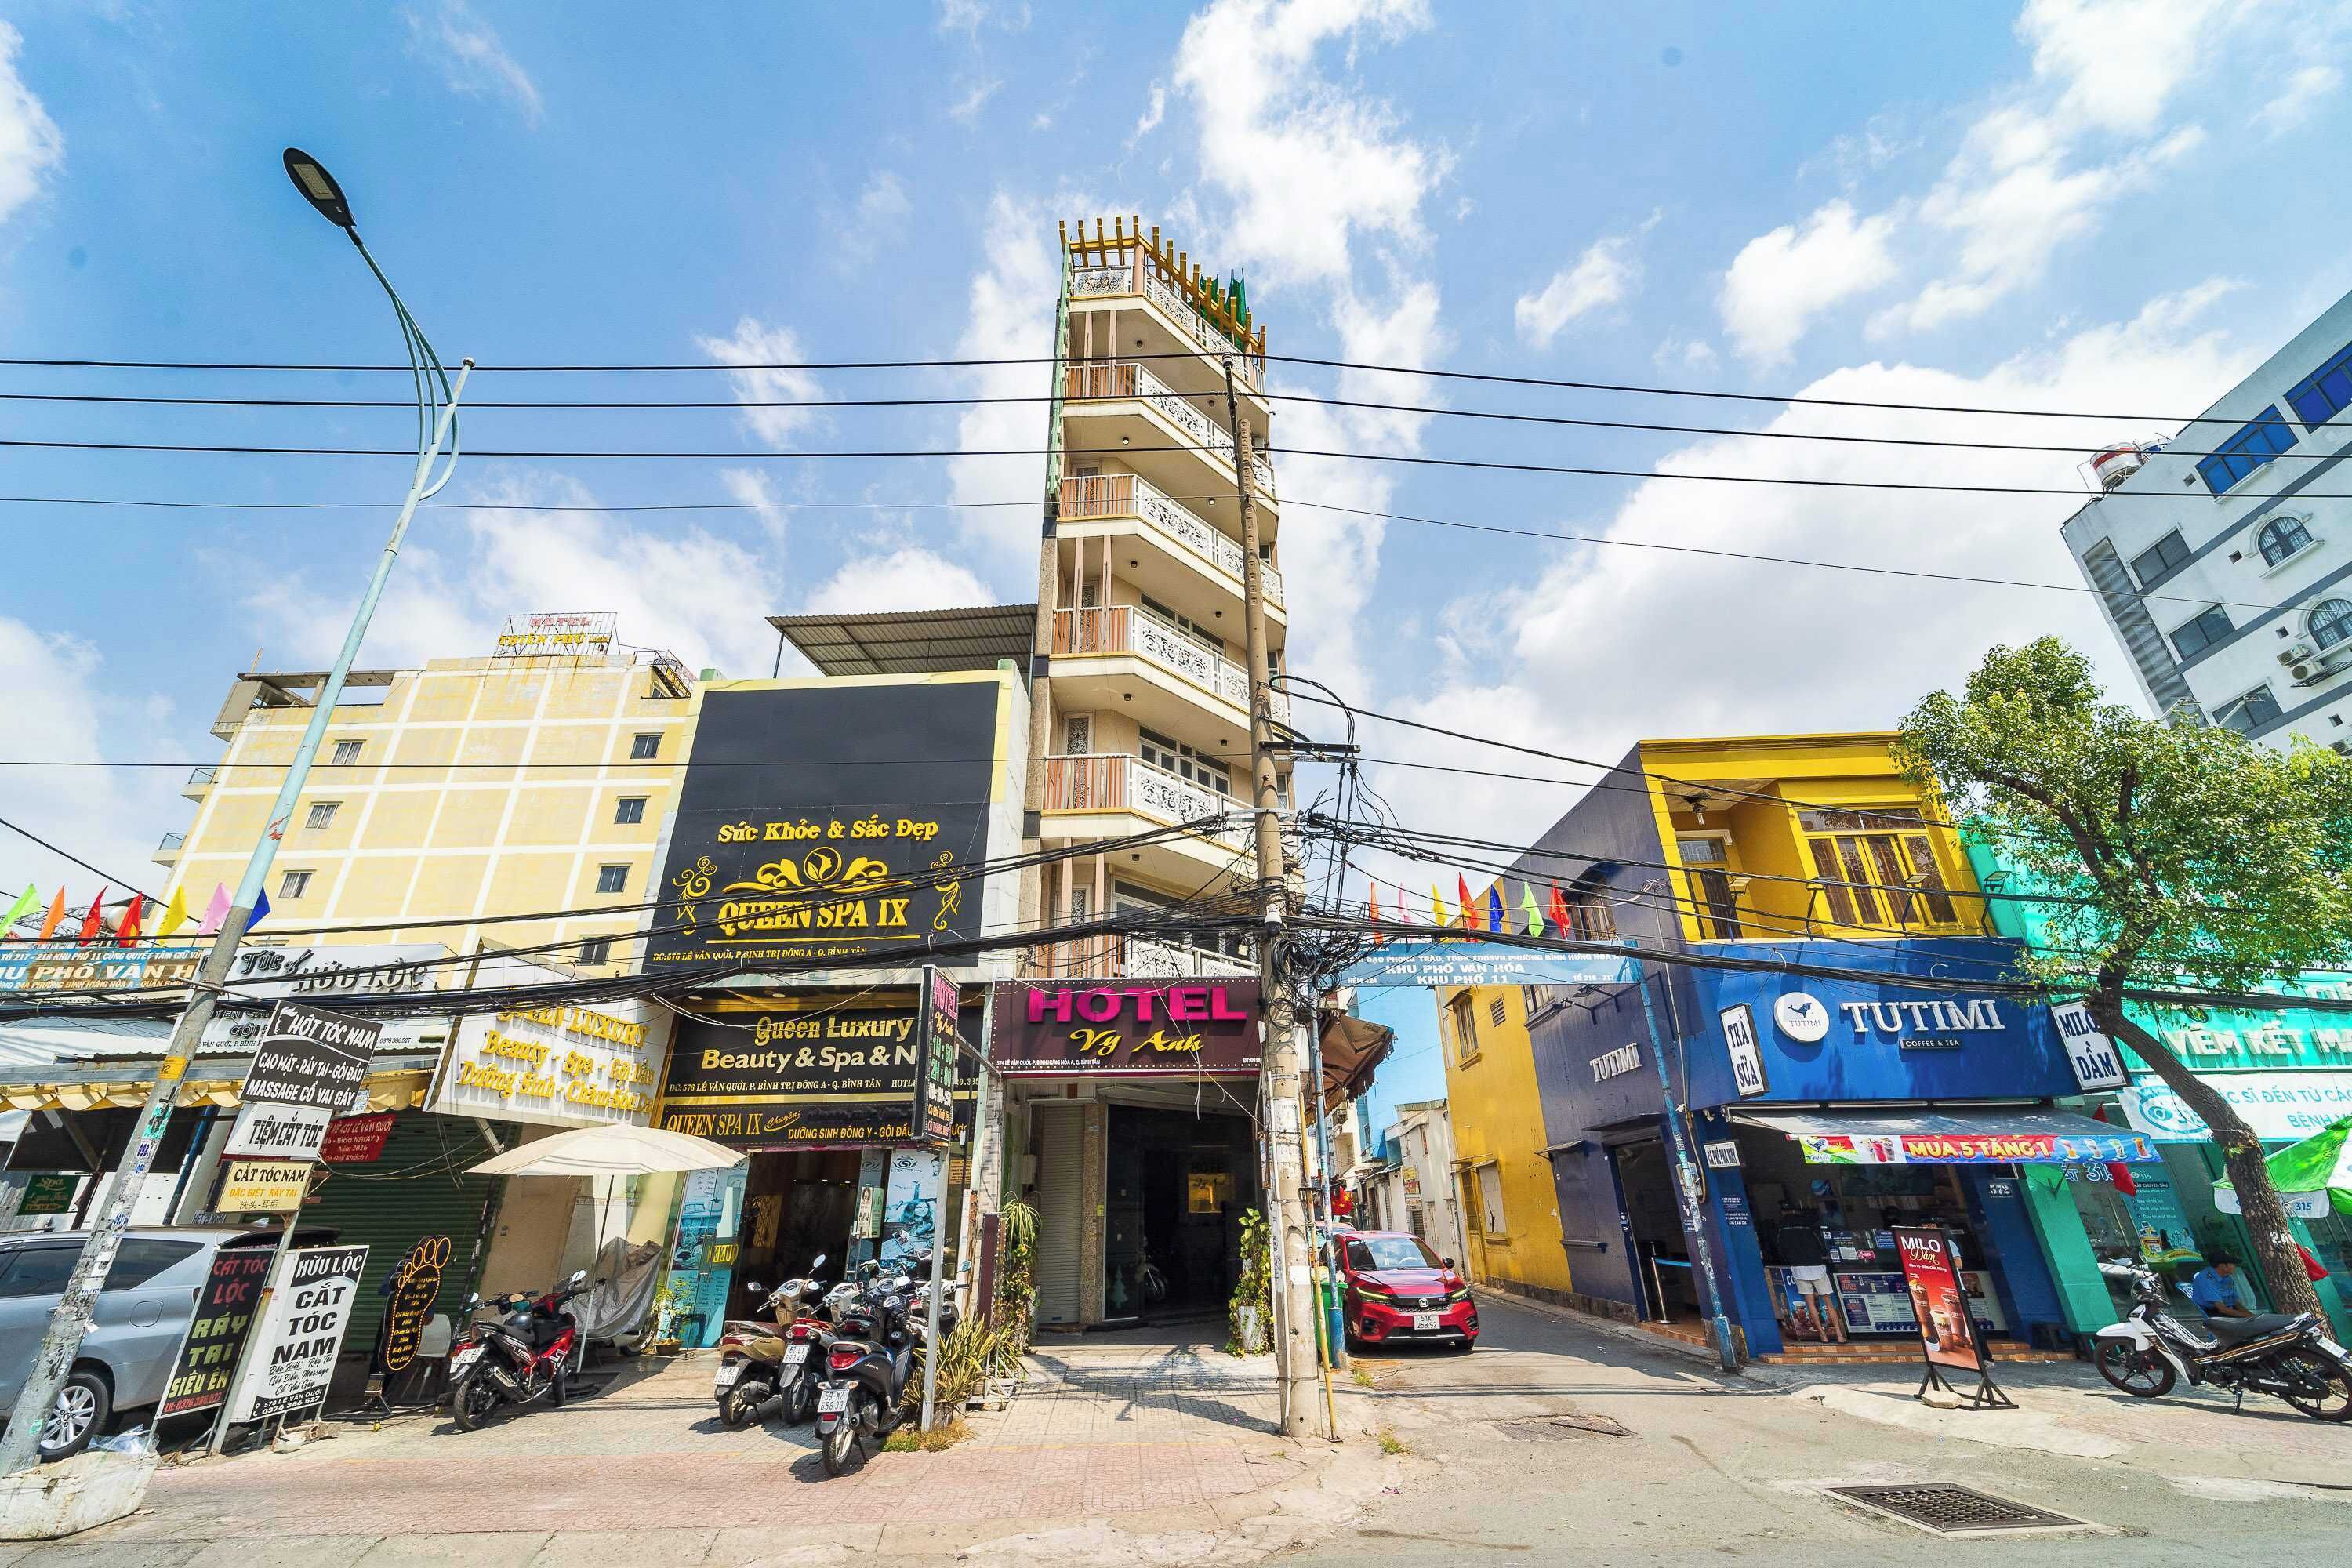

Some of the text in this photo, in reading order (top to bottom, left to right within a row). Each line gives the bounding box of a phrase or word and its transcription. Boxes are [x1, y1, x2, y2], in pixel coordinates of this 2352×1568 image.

[530, 617, 590, 627] HOTEL
[718, 813, 939, 844] Sức Khỏe & Sắc Đẹp
[718, 898, 910, 937] QUEEN SPA IX
[34, 961, 103, 980] PHỐ
[105, 962, 164, 979] VĂN
[1385, 961, 1526, 975] KHU PHỐ VĂN HÓA
[1417, 972, 1510, 985] KHU PHỐ 11
[933, 977, 958, 1020] HOTEL
[1028, 985, 1249, 1023] HOTEL
[566, 1007, 651, 1048] LUXURY
[754, 1015, 913, 1046] Queen Luxury
[1788, 1019, 1822, 1029] TUTIMI
[1840, 1000, 2005, 1033] TUTIMI
[287, 1012, 322, 1040] HỚT
[320, 1020, 347, 1044] TÓC
[343, 1028, 376, 1050] NAM
[1069, 1027, 1204, 1057] Vy Anh
[1727, 1013, 1750, 1049] TRÀ
[2242, 1019, 2306, 1054] KẾT
[480, 1029, 593, 1077] Beauty Spa
[701, 1046, 891, 1074] Beauty & Spa &
[1589, 1042, 1642, 1083] TUTIMI
[2074, 1042, 2118, 1080] DẦM
[315, 1061, 330, 1077] TAI
[1736, 1054, 1759, 1088] SỮA
[245, 1079, 299, 1102] MASSAGE
[317, 1087, 334, 1105] VAI
[333, 1085, 356, 1107] GÁY
[456, 1061, 517, 1098] Dưỡng
[519, 1071, 557, 1098] Sinh
[564, 1078, 611, 1106] Chăm
[696, 1080, 708, 1091] LÊ
[709, 1080, 725, 1091] VĂN
[757, 1080, 779, 1091] BÌNH
[841, 1077, 863, 1089] BÌNH
[865, 1077, 882, 1088] TÂN
[2245, 1087, 2259, 1104] SĨ
[2262, 1085, 2295, 1103] ĐẾN
[2296, 1085, 2322, 1103] TỪ
[666, 1114, 717, 1137] QUEEN
[717, 1114, 743, 1136] SPA
[744, 1113, 764, 1135] IX
[788, 1124, 818, 1140] DƯỠNG
[818, 1127, 840, 1139] SINH
[840, 1123, 864, 1139] ĐÔNG
[879, 1123, 895, 1141] GỘI
[2286, 1112, 2332, 1132] BỆNH
[1960, 1141, 1973, 1158] 5
[1976, 1137, 2036, 1162] TẶNG
[2036, 1141, 2052, 1157] 1
[37, 1177, 64, 1190] Spa
[234, 1162, 307, 1182] CẮT TÓC NAM
[285, 1189, 298, 1198] TAI
[1989, 1185, 2010, 1195] 572
[2295, 1202, 2313, 1212] 315
[1900, 1236, 1941, 1253] MILO
[242, 1255, 268, 1275] TÓC
[295, 1251, 363, 1279] HỮU LỘC
[212, 1278, 251, 1308] LỘC
[294, 1280, 347, 1310] CẮT
[191, 1311, 249, 1339] RÁY
[289, 1310, 338, 1337] TÓC
[270, 1335, 337, 1366] NAM
[262, 1405, 284, 1414] 0376
